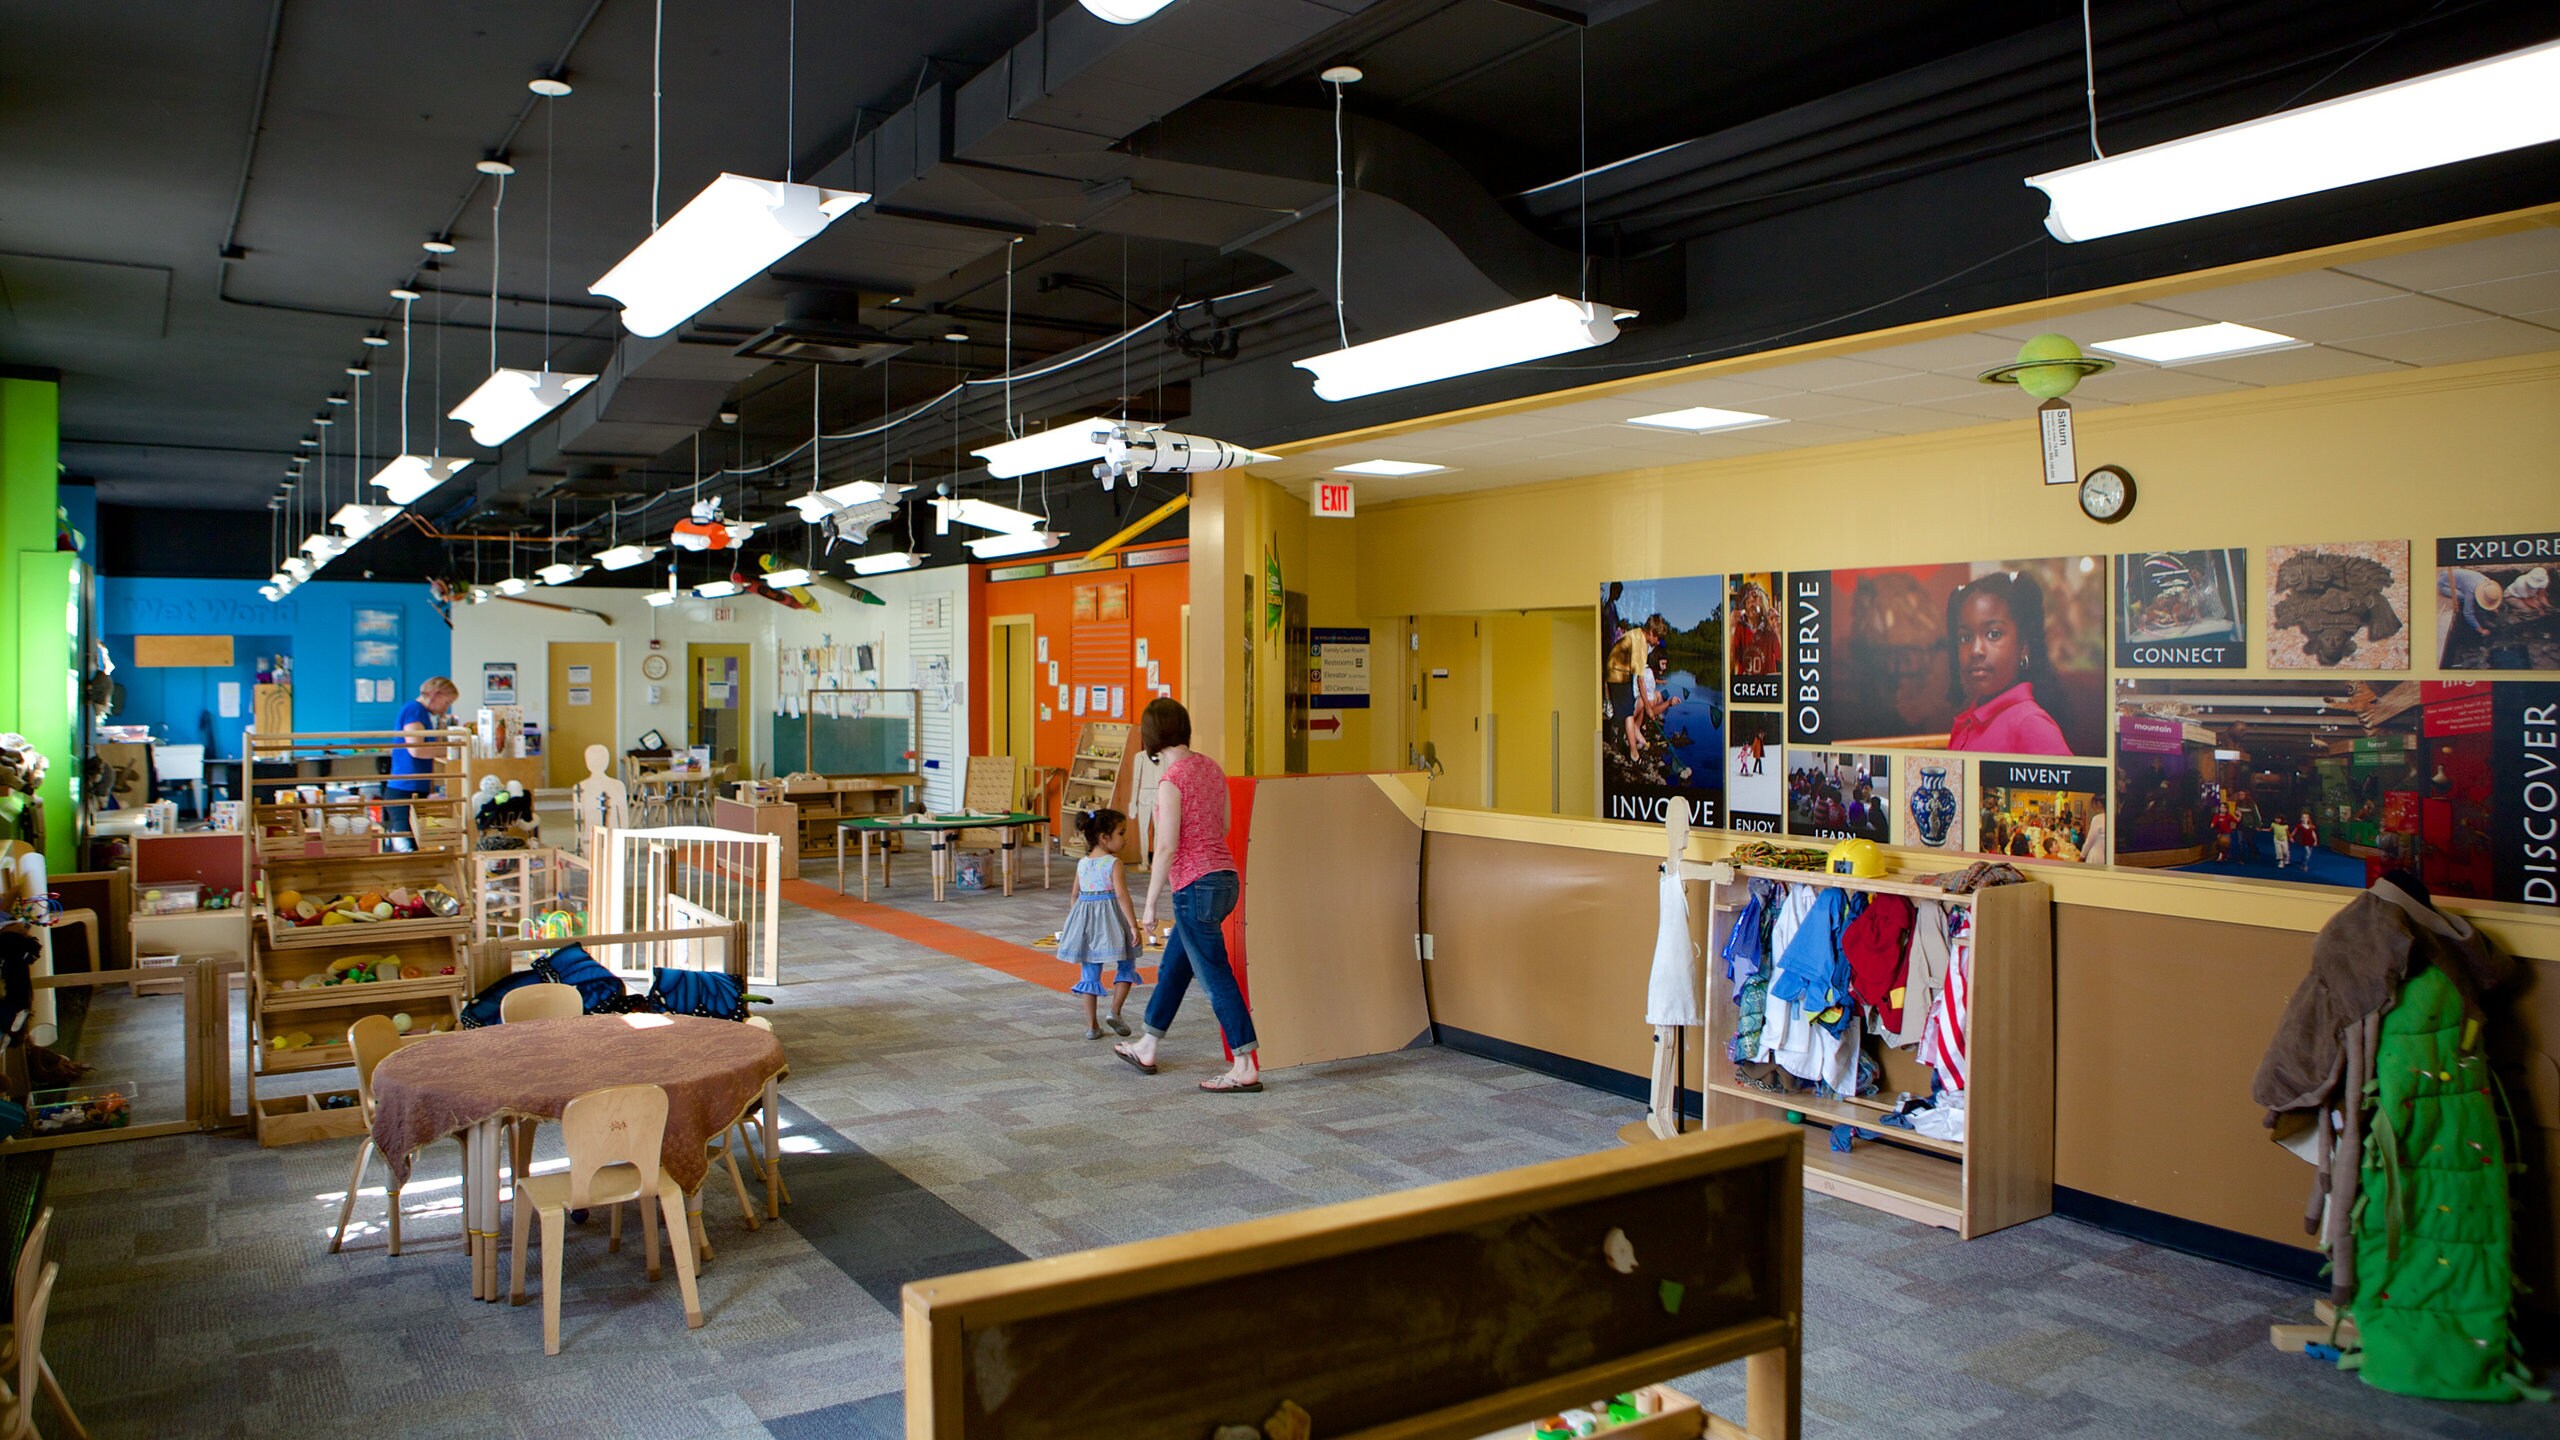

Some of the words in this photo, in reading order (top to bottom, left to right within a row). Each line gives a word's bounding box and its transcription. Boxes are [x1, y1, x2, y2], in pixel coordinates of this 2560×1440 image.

[2058, 411, 2067, 445] Saturn
[1321, 484, 1349, 512] EXIT
[715, 608, 731, 621] EXIT
[1799, 581, 1820, 735] OBSERVE
[2133, 648, 2225, 663] CONNECT
[1733, 683, 1778, 696] CREATE
[2134, 723, 2172, 733] mountain
[2010, 767, 2071, 785] INVENT
[1612, 794, 1714, 826] INVOVE
[2523, 703, 2558, 904] DISCOVER
[1736, 818, 1775, 833] ENJOY
